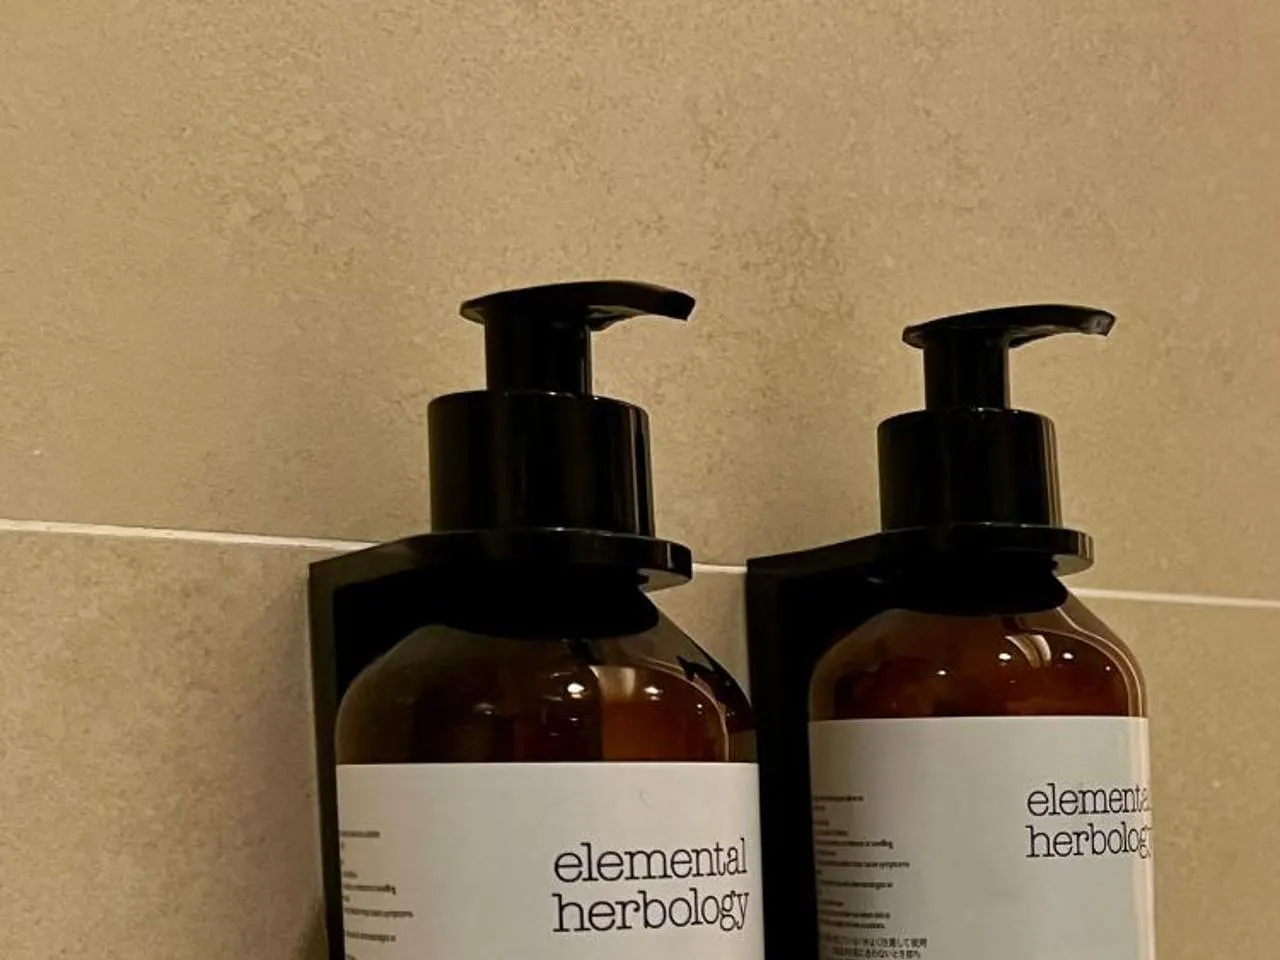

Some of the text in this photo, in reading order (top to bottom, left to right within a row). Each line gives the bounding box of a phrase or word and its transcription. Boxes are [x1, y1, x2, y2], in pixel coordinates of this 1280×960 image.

[1027, 783, 1151, 816] elementa
[554, 837, 748, 882] elemental
[1025, 821, 1151, 859] herbolog
[551, 887, 749, 932] herbology
